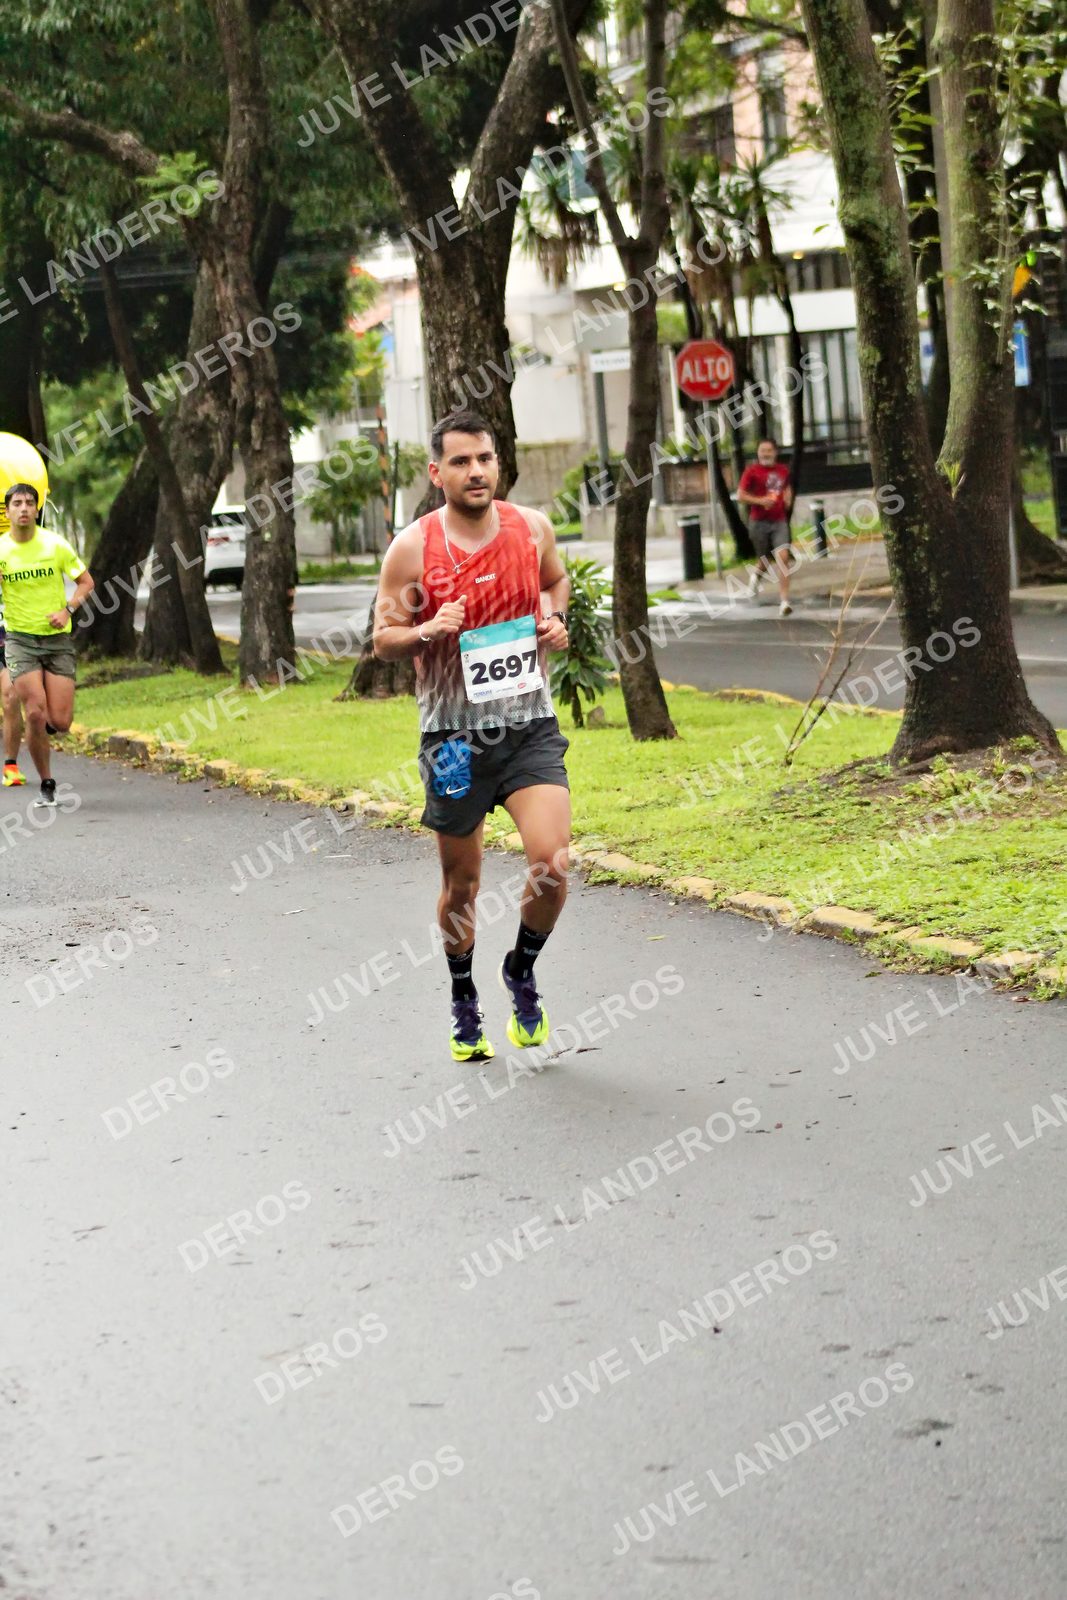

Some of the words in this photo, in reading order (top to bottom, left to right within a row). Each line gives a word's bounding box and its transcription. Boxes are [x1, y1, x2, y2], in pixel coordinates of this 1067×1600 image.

[681, 356, 731, 385] ALTO
[2, 567, 54, 583] PERDURA
[468, 649, 538, 686] 2697
